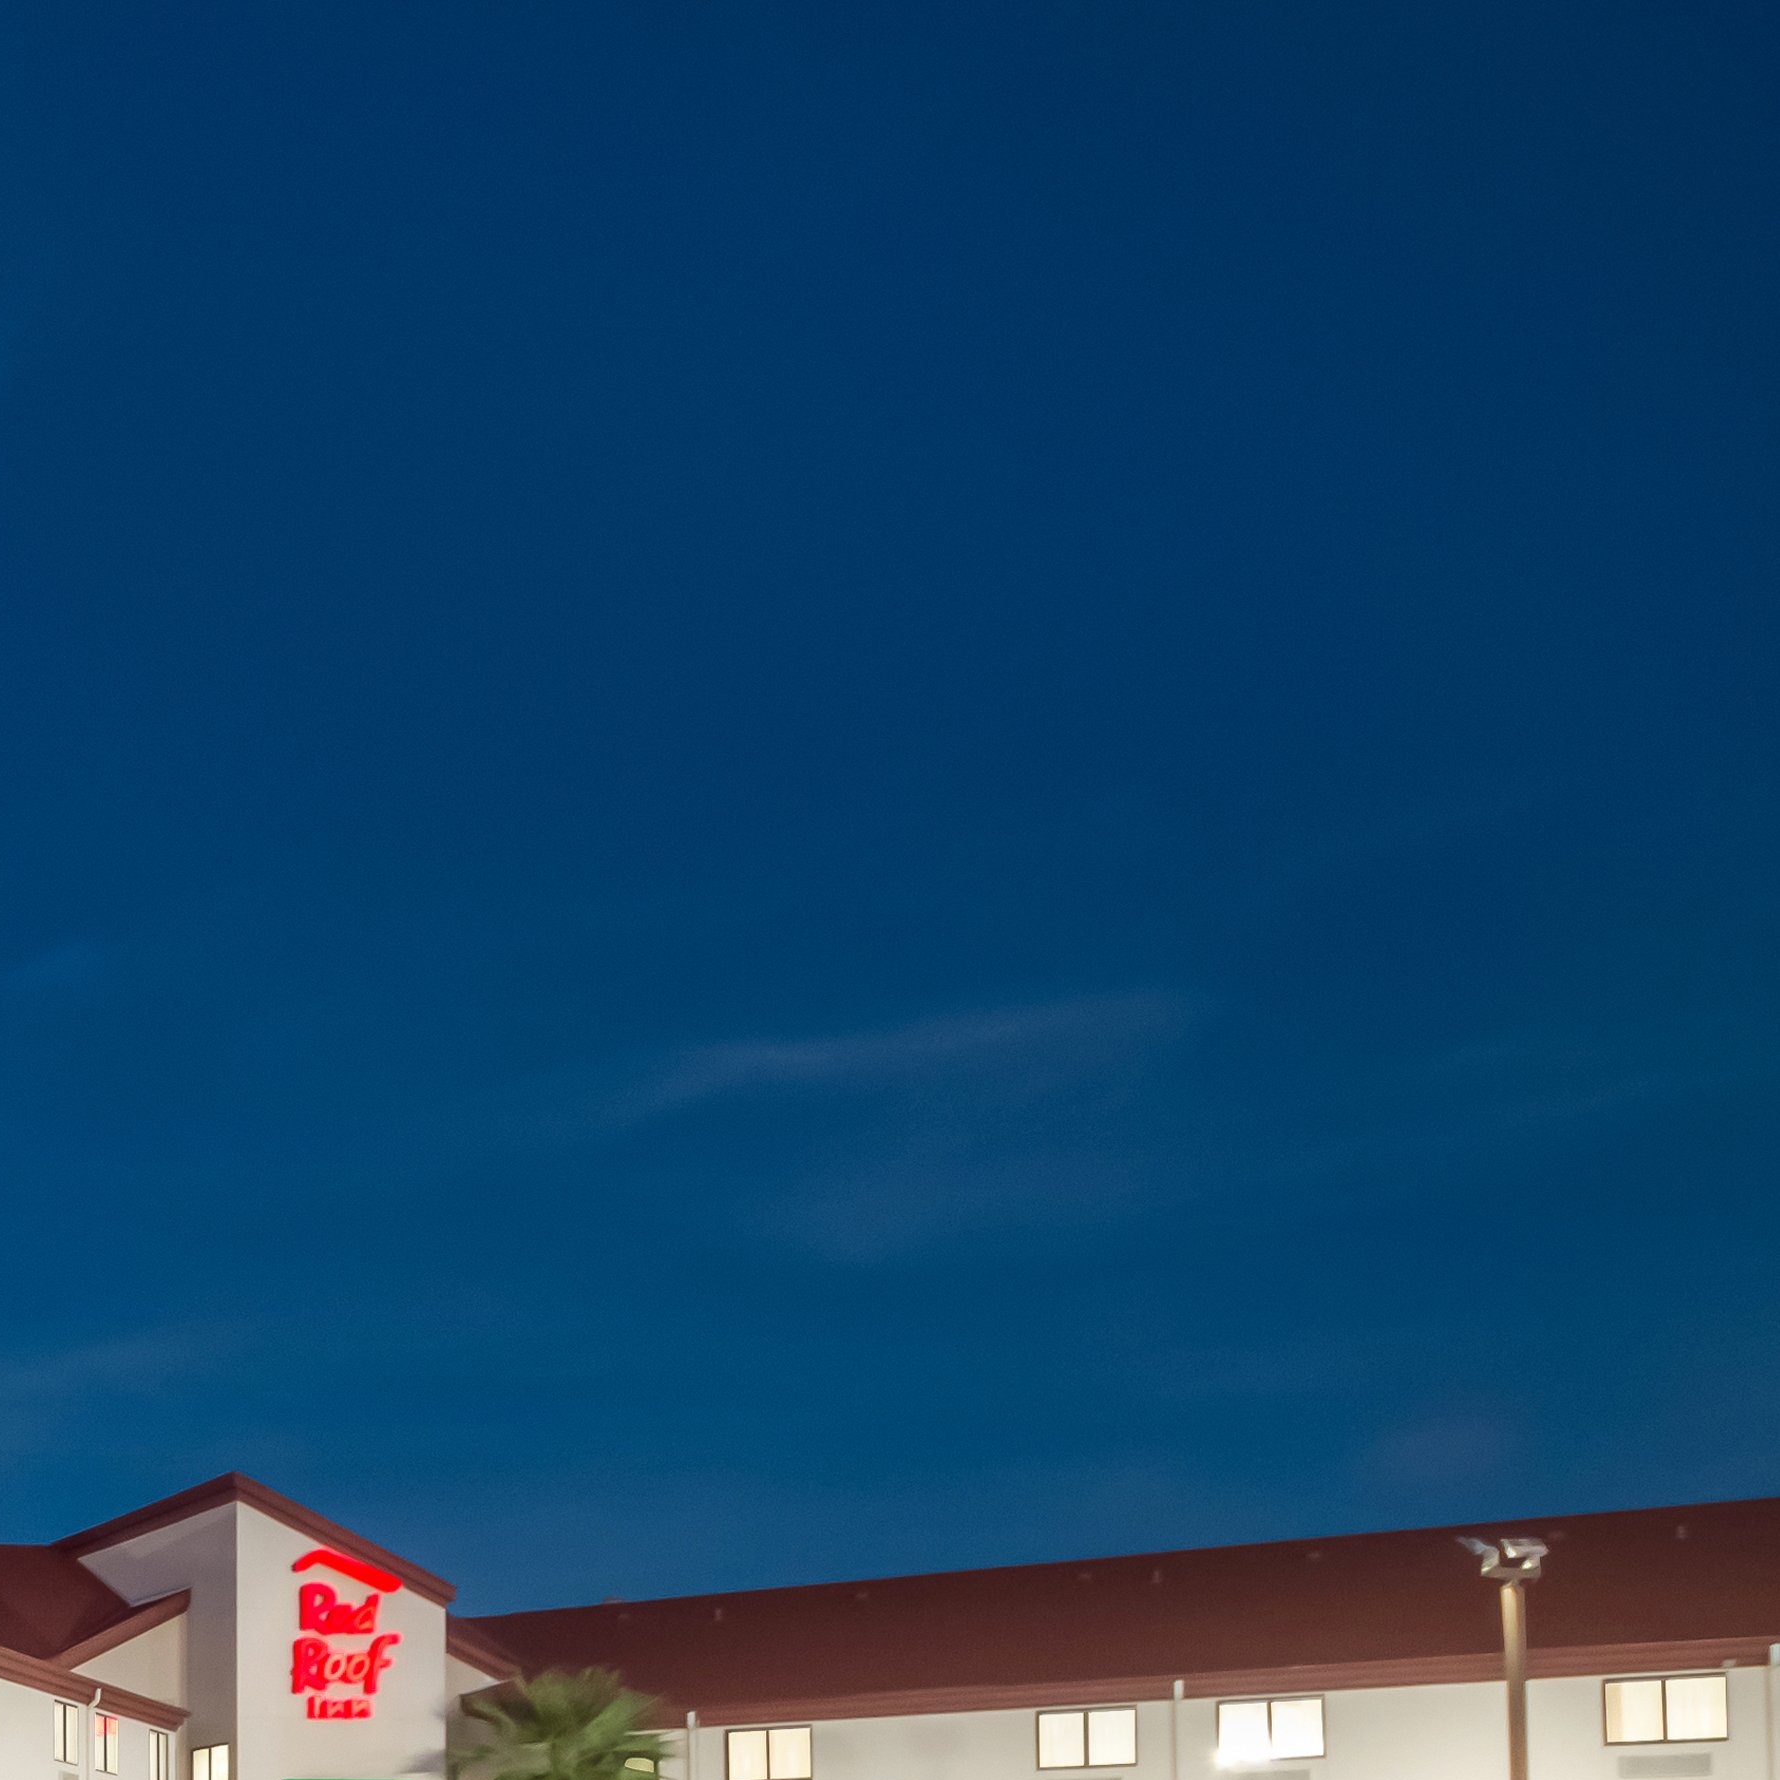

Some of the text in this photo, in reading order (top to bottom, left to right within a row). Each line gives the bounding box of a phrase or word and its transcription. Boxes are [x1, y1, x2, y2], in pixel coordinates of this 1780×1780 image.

[299, 1582, 381, 1636] Red
[291, 1633, 402, 1695] Roof
[306, 1696, 372, 1720] Inn
